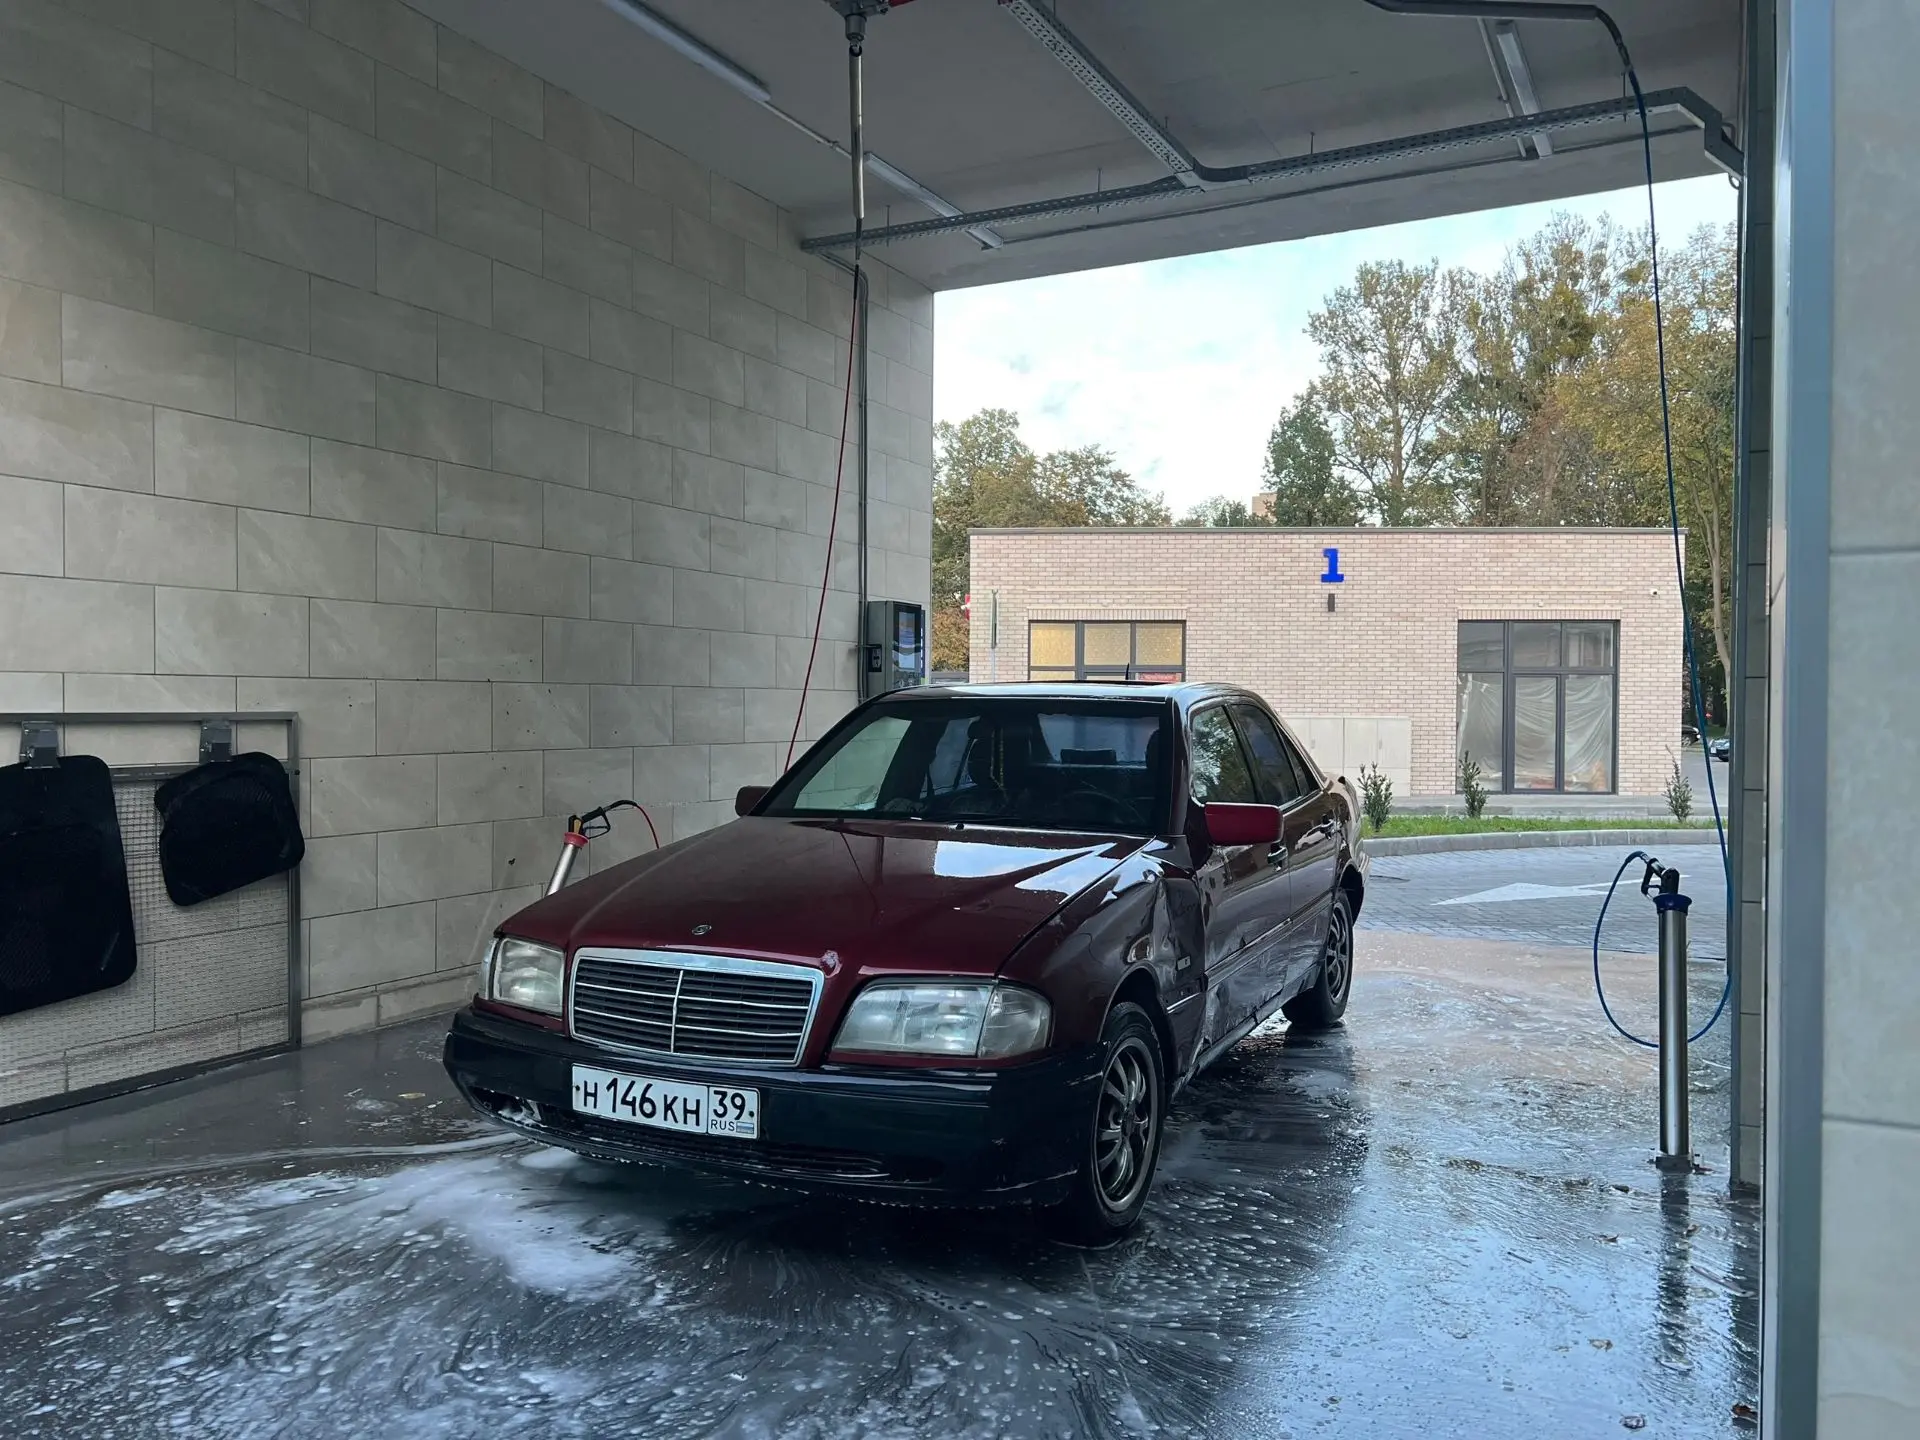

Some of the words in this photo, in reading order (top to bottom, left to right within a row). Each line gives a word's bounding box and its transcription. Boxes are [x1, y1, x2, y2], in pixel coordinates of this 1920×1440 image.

[1321, 548, 1344, 582] 1
[713, 1090, 746, 1121] 39
[710, 1119, 735, 1132] RUS
